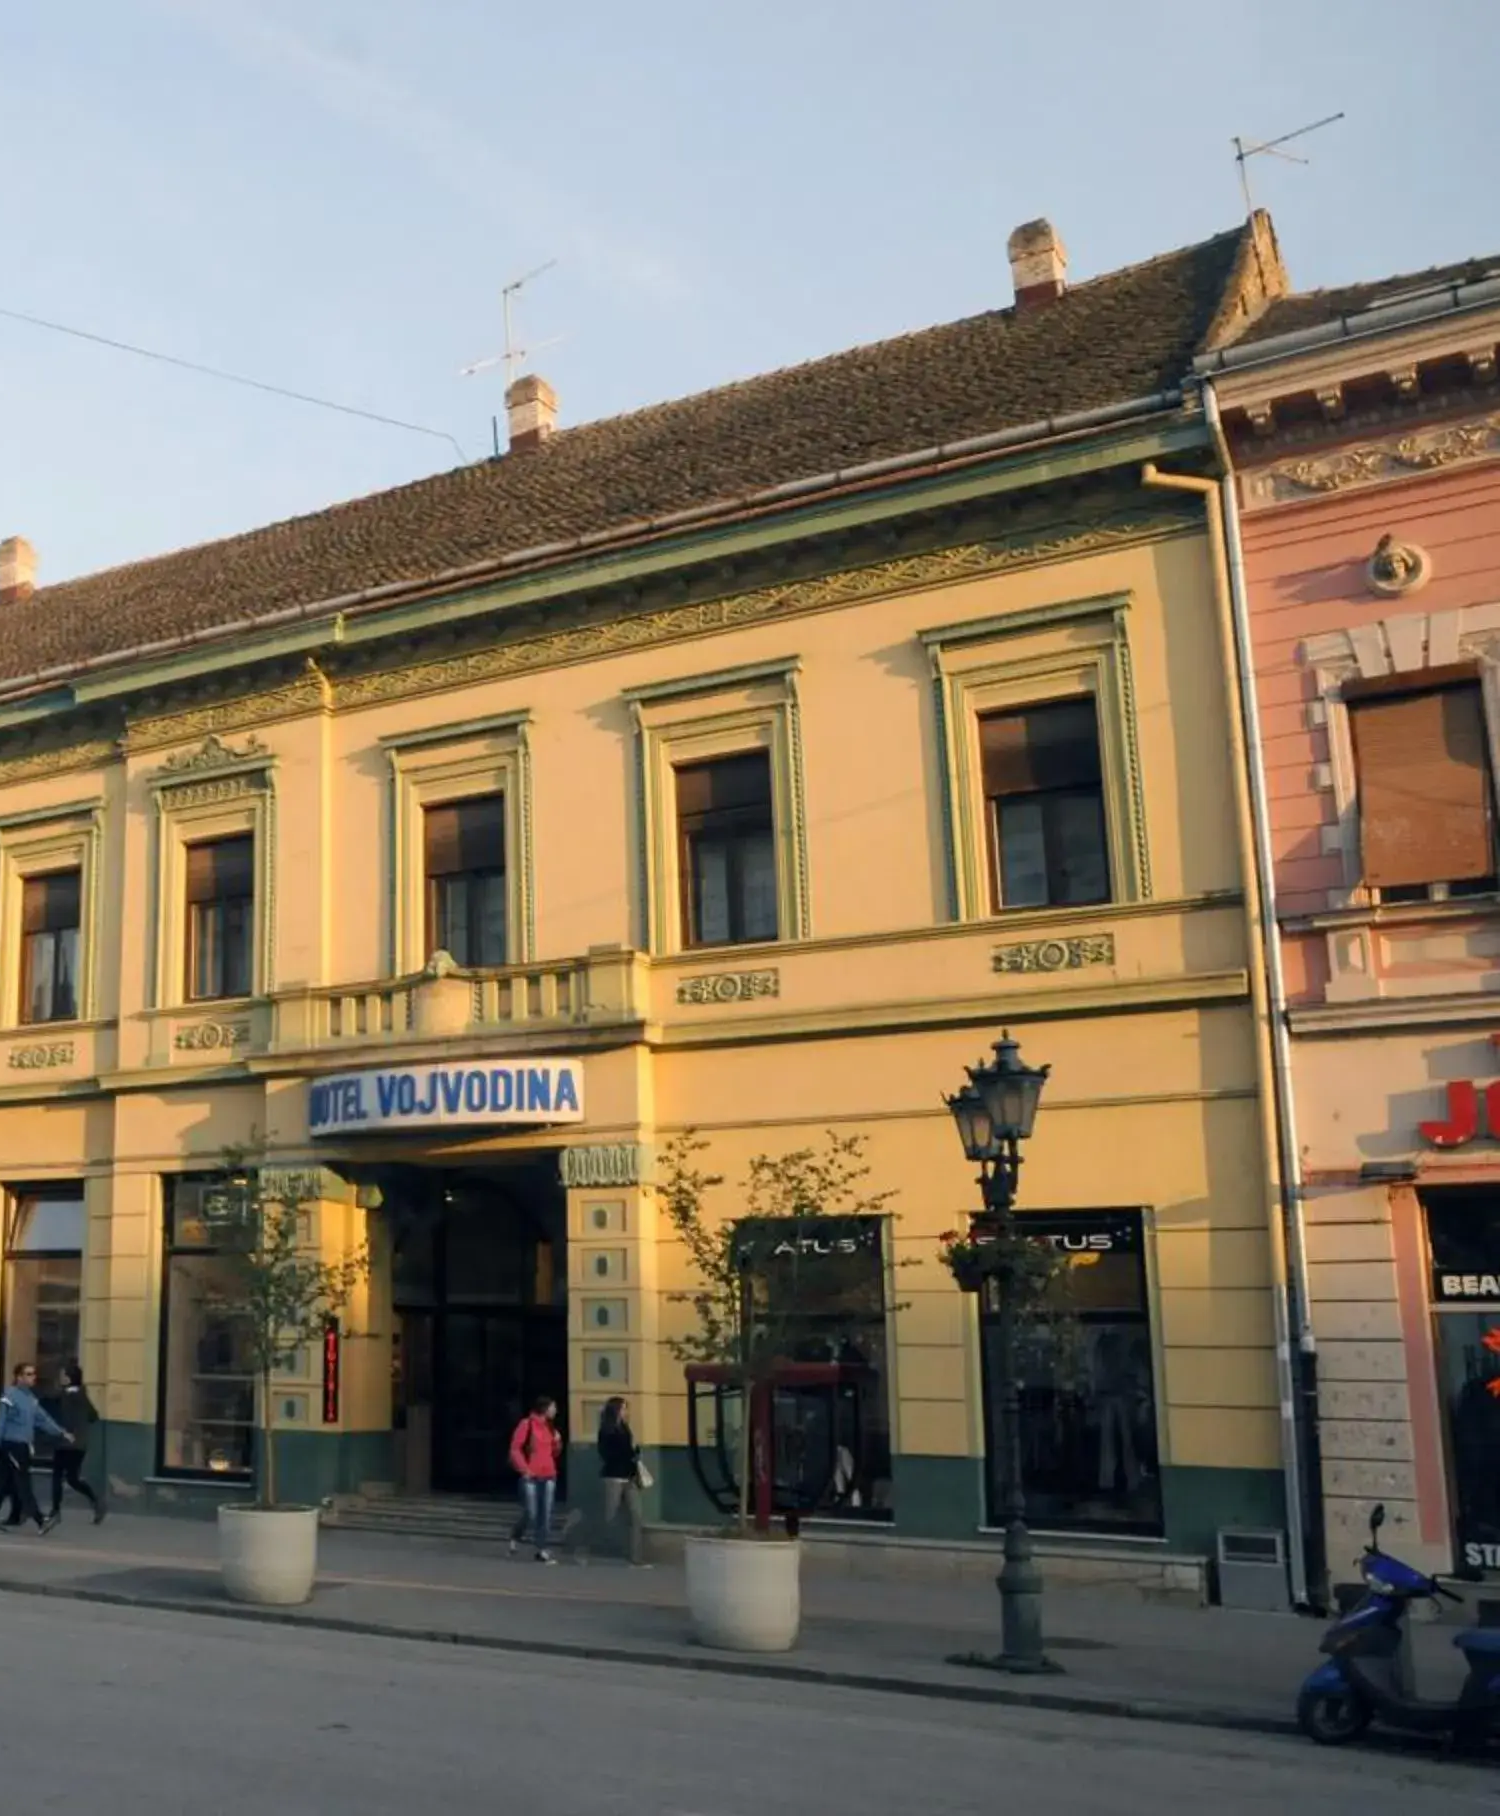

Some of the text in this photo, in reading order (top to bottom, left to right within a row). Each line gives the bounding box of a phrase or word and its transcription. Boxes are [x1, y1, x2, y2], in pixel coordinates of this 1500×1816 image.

[377, 1068, 579, 1118] VOJVODINA
[1418, 1079, 1500, 1144] J
[740, 1237, 858, 1255] ATUS
[1441, 1274, 1500, 1296] BEA
